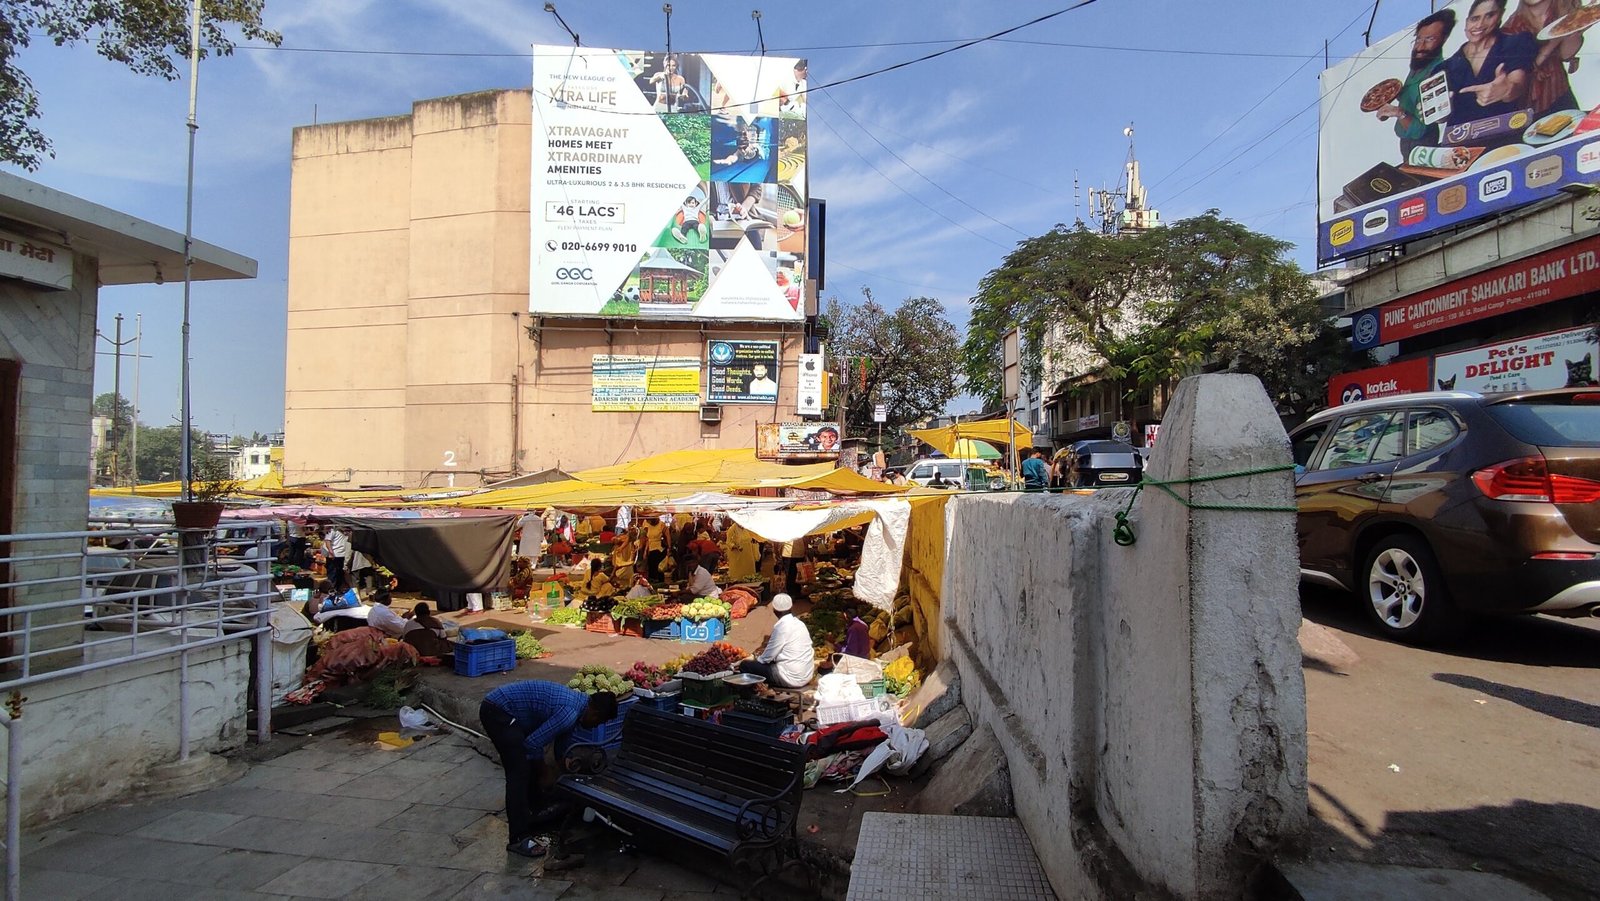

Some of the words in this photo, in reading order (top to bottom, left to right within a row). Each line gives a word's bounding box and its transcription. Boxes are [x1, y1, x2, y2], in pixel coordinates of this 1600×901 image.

[549, 81, 585, 103] XTRA
[589, 91, 616, 106] LIFE
[548, 126, 629, 139] XTRAVAGANT
[548, 140, 583, 148] HOMES
[585, 140, 613, 150] MEET
[547, 151, 643, 164] XTRAORDINARY
[1581, 152, 1600, 163] SL
[547, 165, 602, 175] AMENITIES
[561, 242, 610, 252] 020-6699
[612, 243, 637, 252] 9010
[1384, 308, 1406, 328] PUNE
[1408, 289, 1469, 321] CANTONMENT
[1471, 271, 1526, 303] SAHAKARI
[1531, 259, 1566, 287] BANK
[1570, 251, 1600, 275] LTD.
[1488, 345, 1528, 359] Pet's
[711, 367, 726, 375] Good
[1465, 351, 1555, 379] DELIGHT
[711, 376, 726, 384] Good
[711, 384, 725, 392] Good
[1366, 379, 1398, 395] kotak
[443, 450, 458, 466] 2
